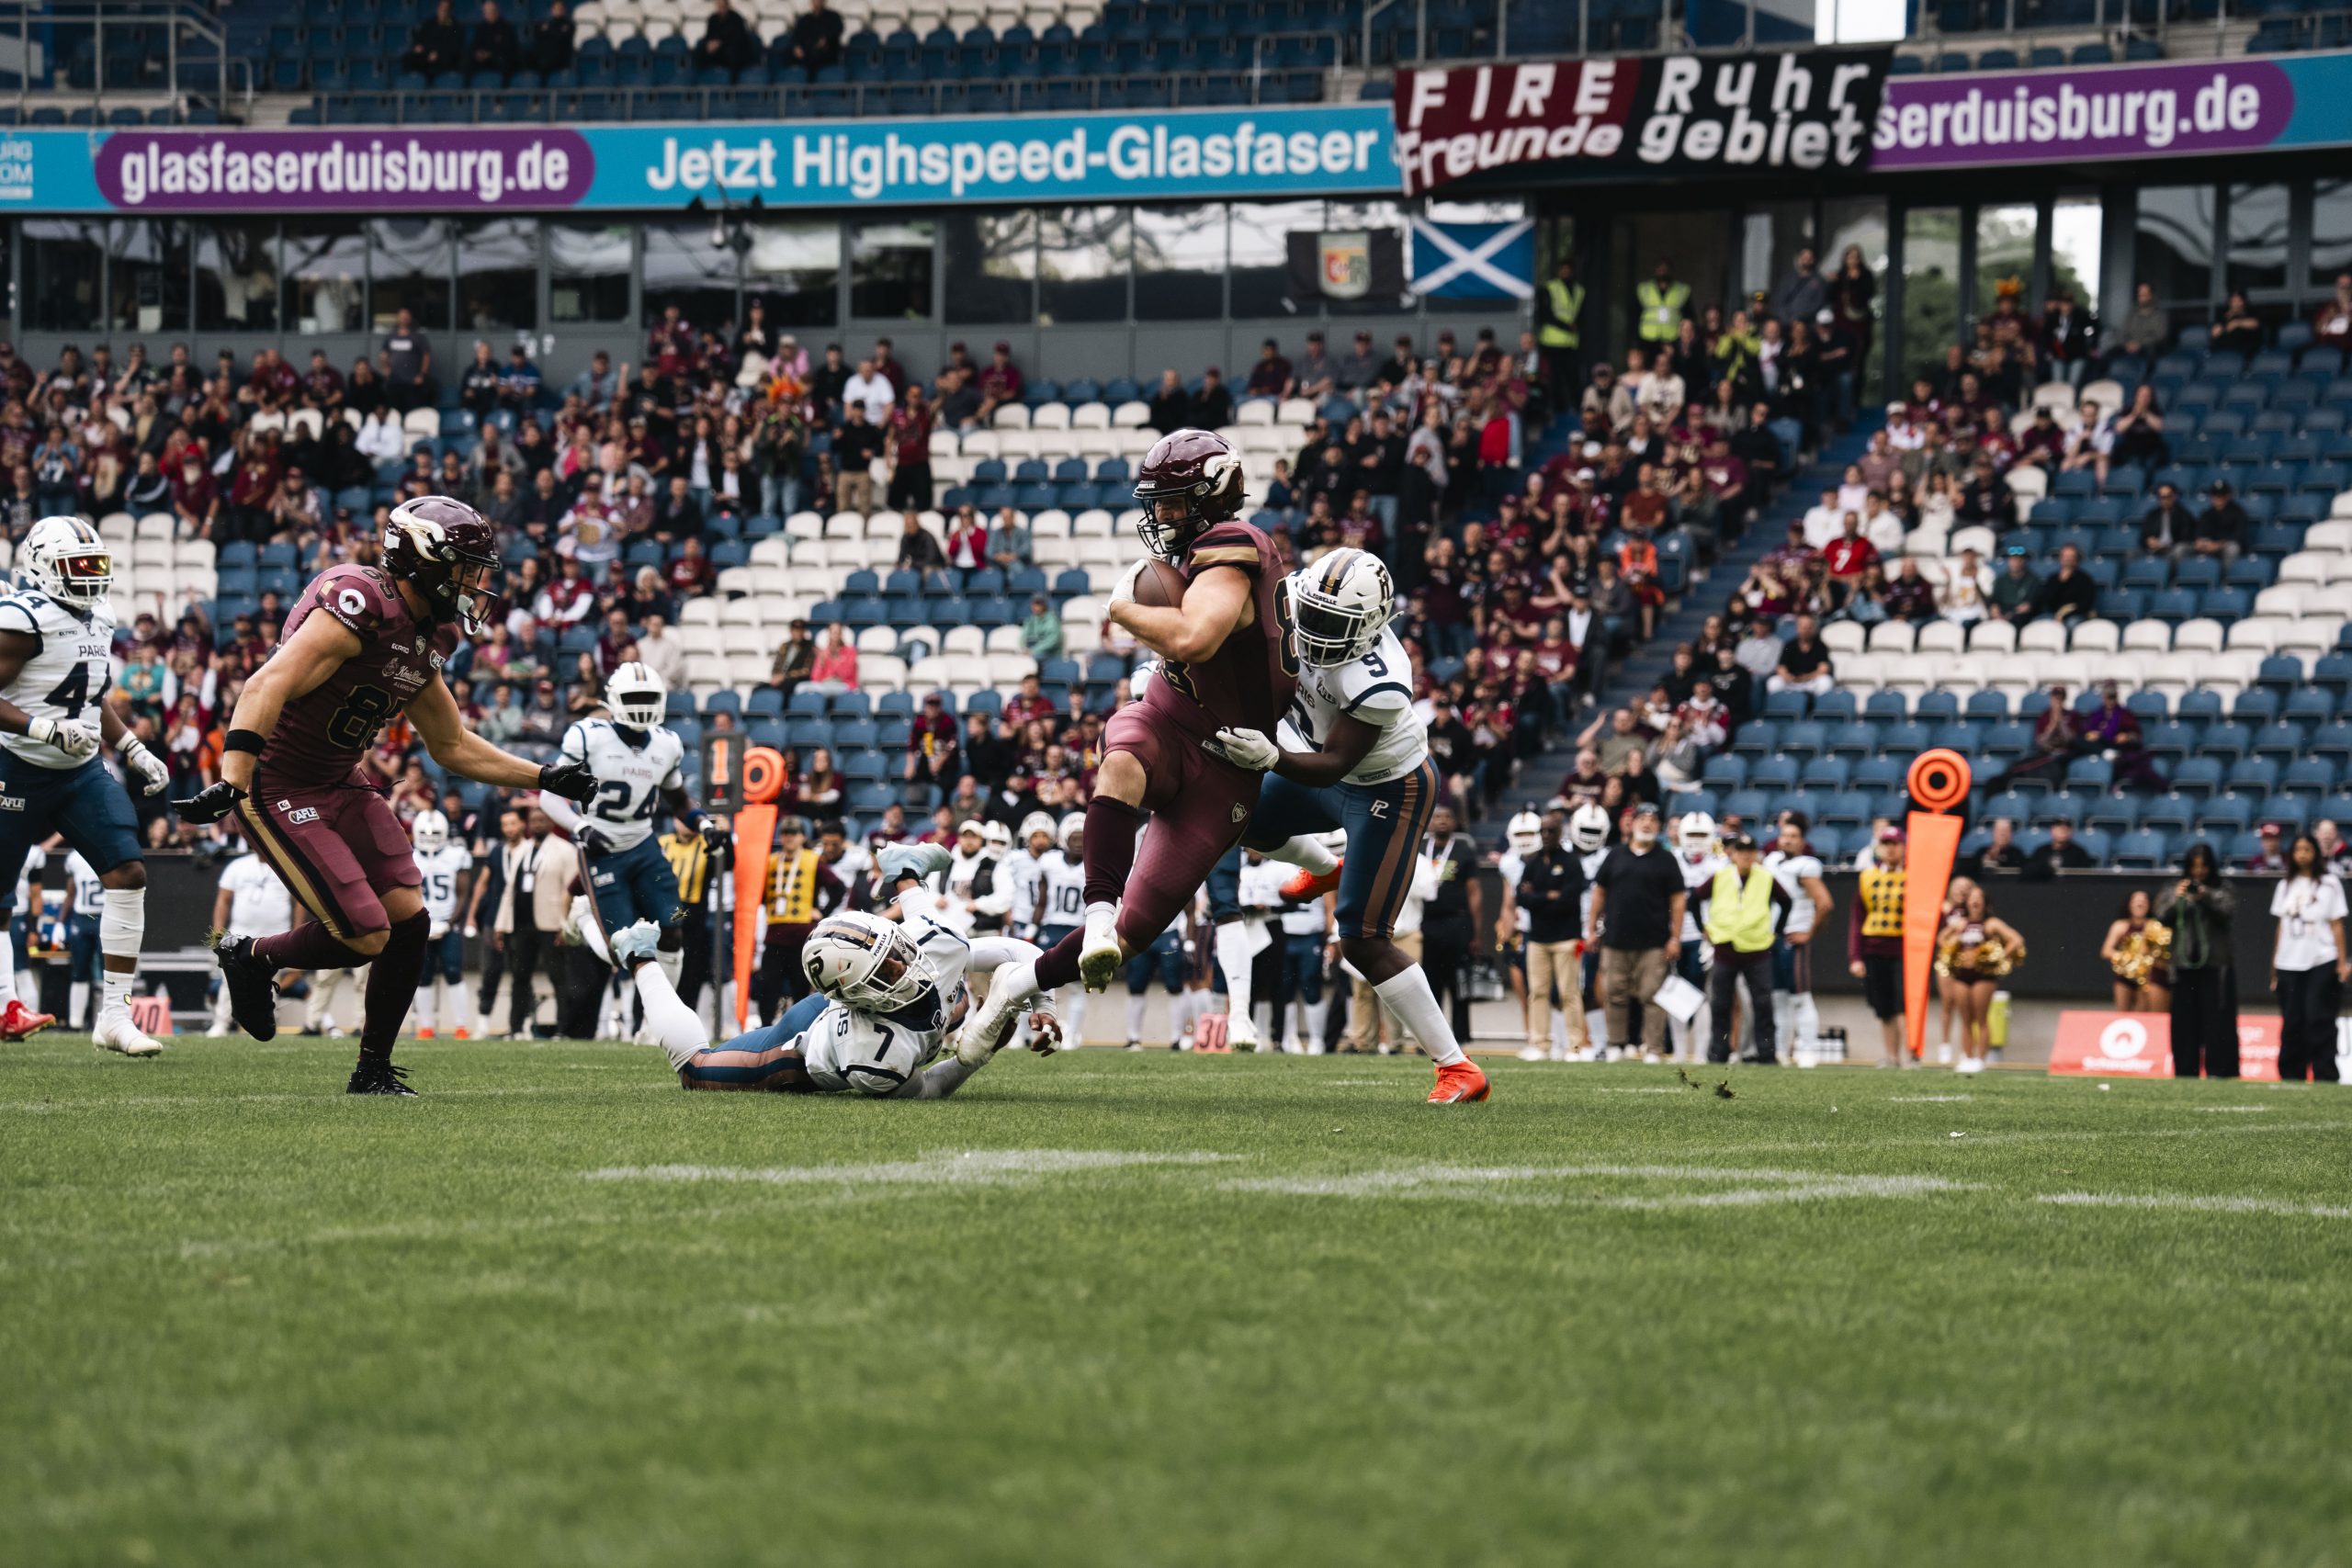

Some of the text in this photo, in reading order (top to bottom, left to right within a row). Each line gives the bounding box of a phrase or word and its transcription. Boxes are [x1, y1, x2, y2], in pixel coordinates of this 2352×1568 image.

[1408, 51, 1871, 129] FIRE Ruhr
[1636, 102, 1865, 169] gebiet
[120, 140, 571, 205] glasfaserduisburg.de
[646, 121, 1379, 197] Jetzt Highspeed-Glasfaser
[1396, 114, 1624, 198] Freunde
[323, 602, 361, 631] Schindler
[1312, 592, 1338, 606] FORELLE
[78, 645, 107, 658] PARIS
[1361, 651, 1389, 678] 9
[710, 738, 729, 785] 1
[295, 808, 318, 822] AFLE
[596, 781, 660, 823] 24
[82, 880, 105, 906] 12
[1056, 886, 1081, 914] 10
[873, 1022, 896, 1063] 7
[1198, 1018, 1229, 1048] 30
